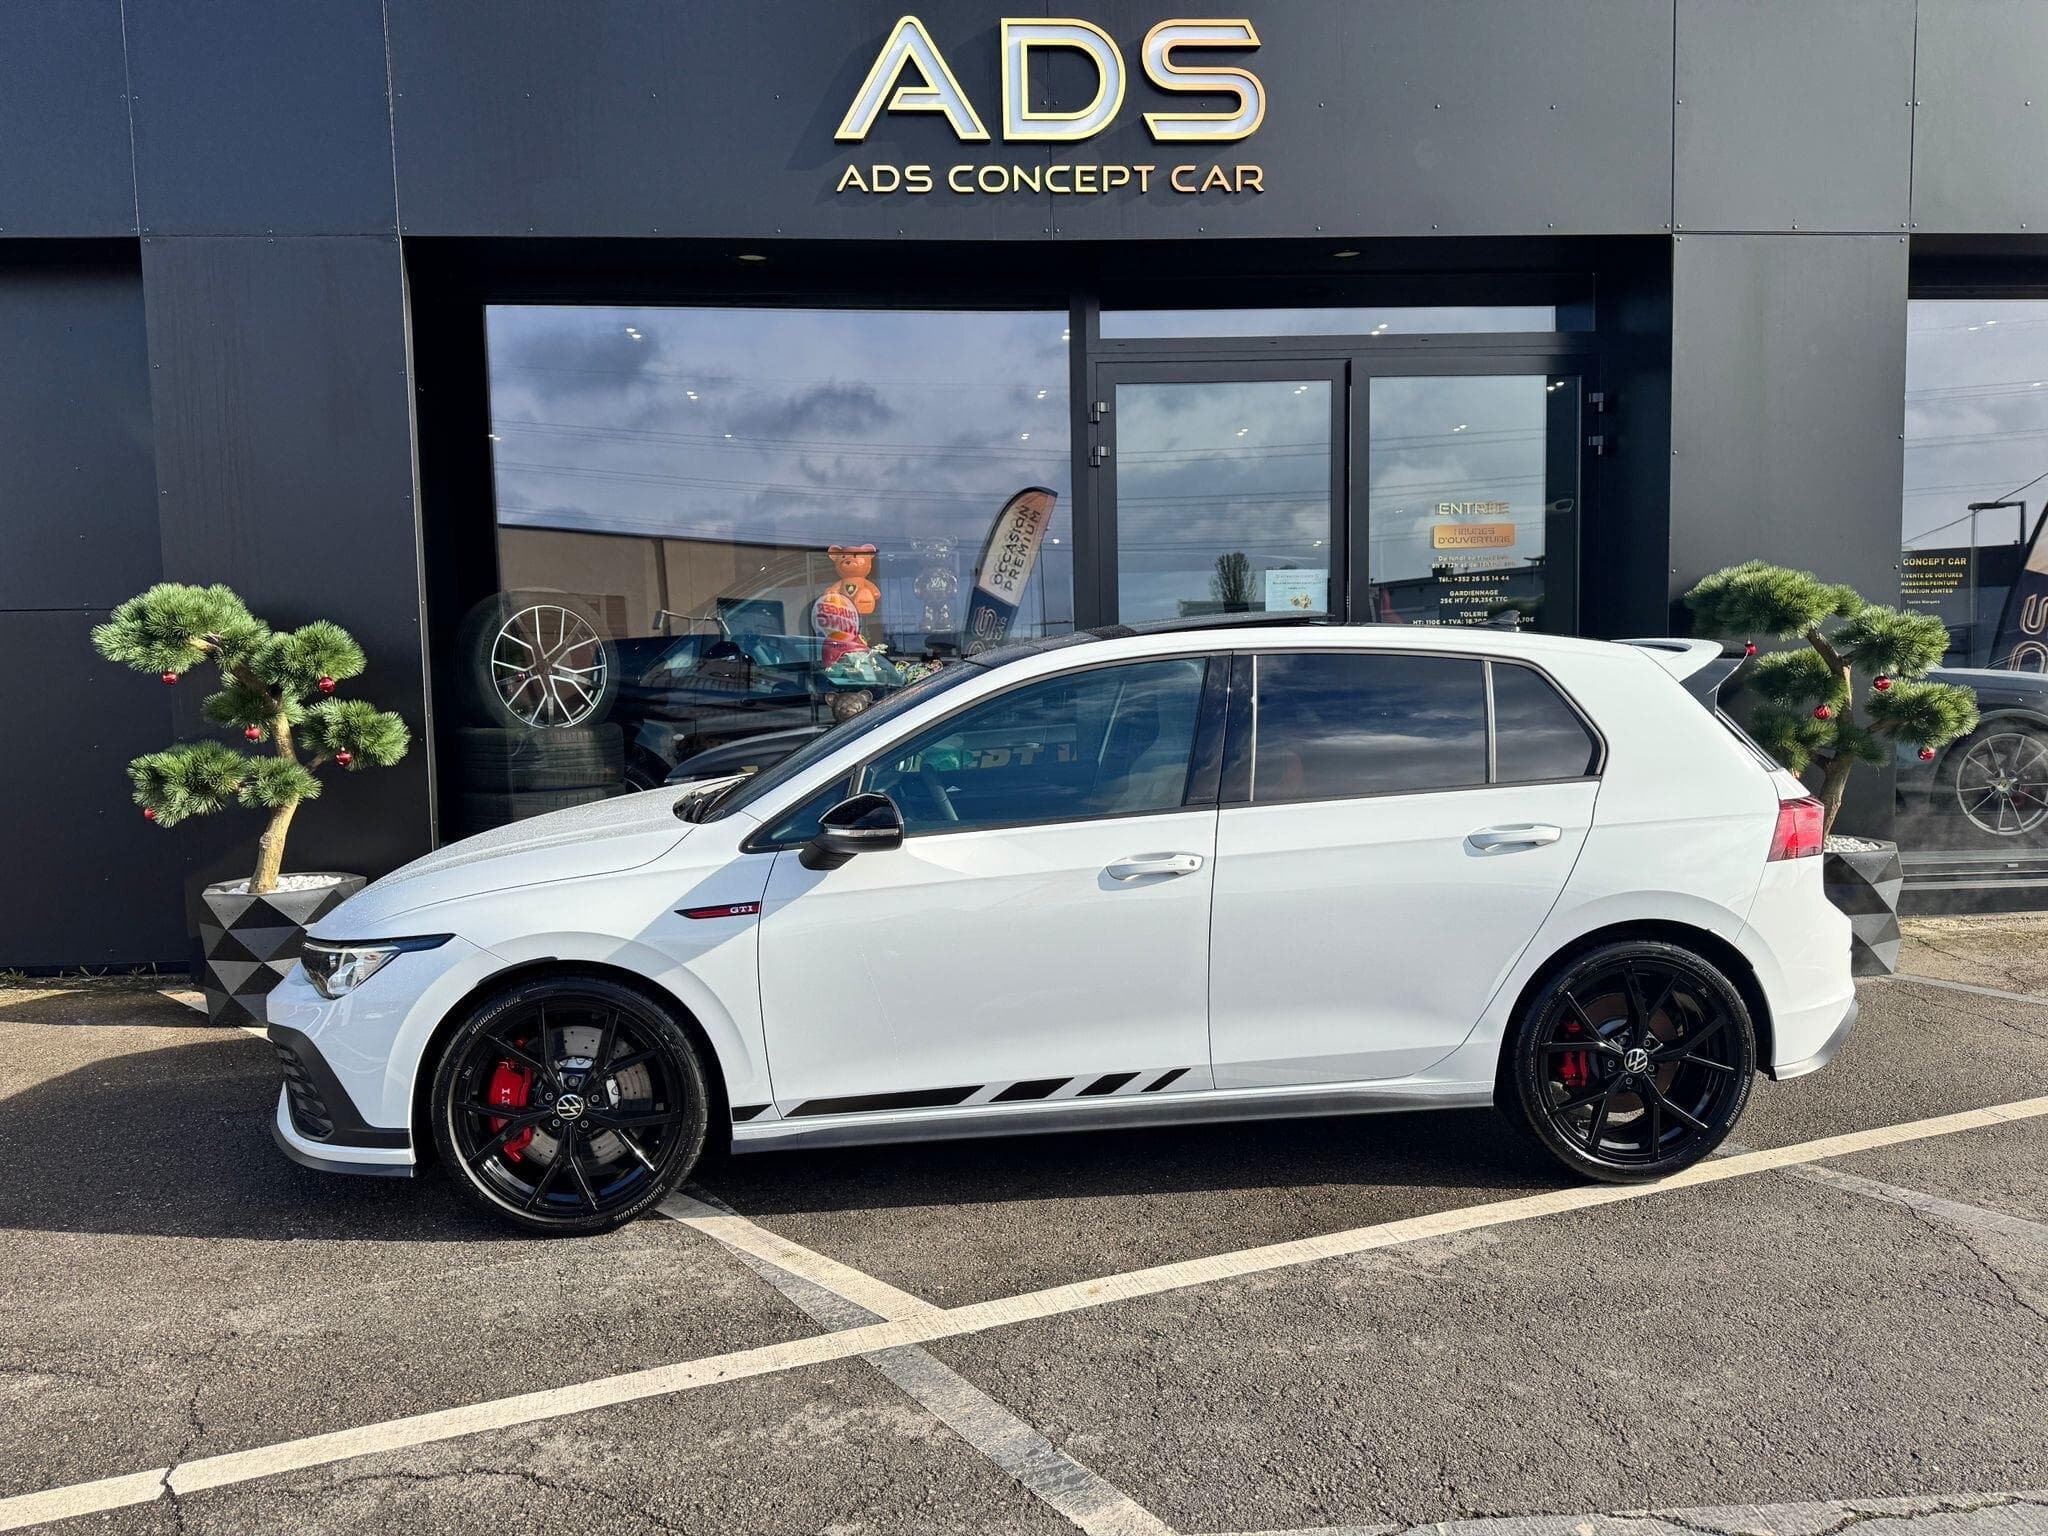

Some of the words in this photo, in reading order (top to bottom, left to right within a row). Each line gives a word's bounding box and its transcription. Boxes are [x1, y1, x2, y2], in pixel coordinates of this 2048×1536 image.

[834, 15, 1266, 141] ADS
[836, 164, 933, 193] ADS
[948, 164, 1156, 193] CONCEPT
[1170, 164, 1265, 193] CAR
[1454, 527, 1495, 535] HEURES
[1438, 535, 1511, 544] D'OUVERTURE
[994, 505, 1030, 585] OCCASION
[1004, 510, 1041, 591] PREMIUM
[1903, 558, 1946, 566] CONCEPT
[1948, 557, 1967, 565] CAR
[1449, 589, 1499, 597] GARDIENNAGE
[730, 905, 753, 914] GTI
